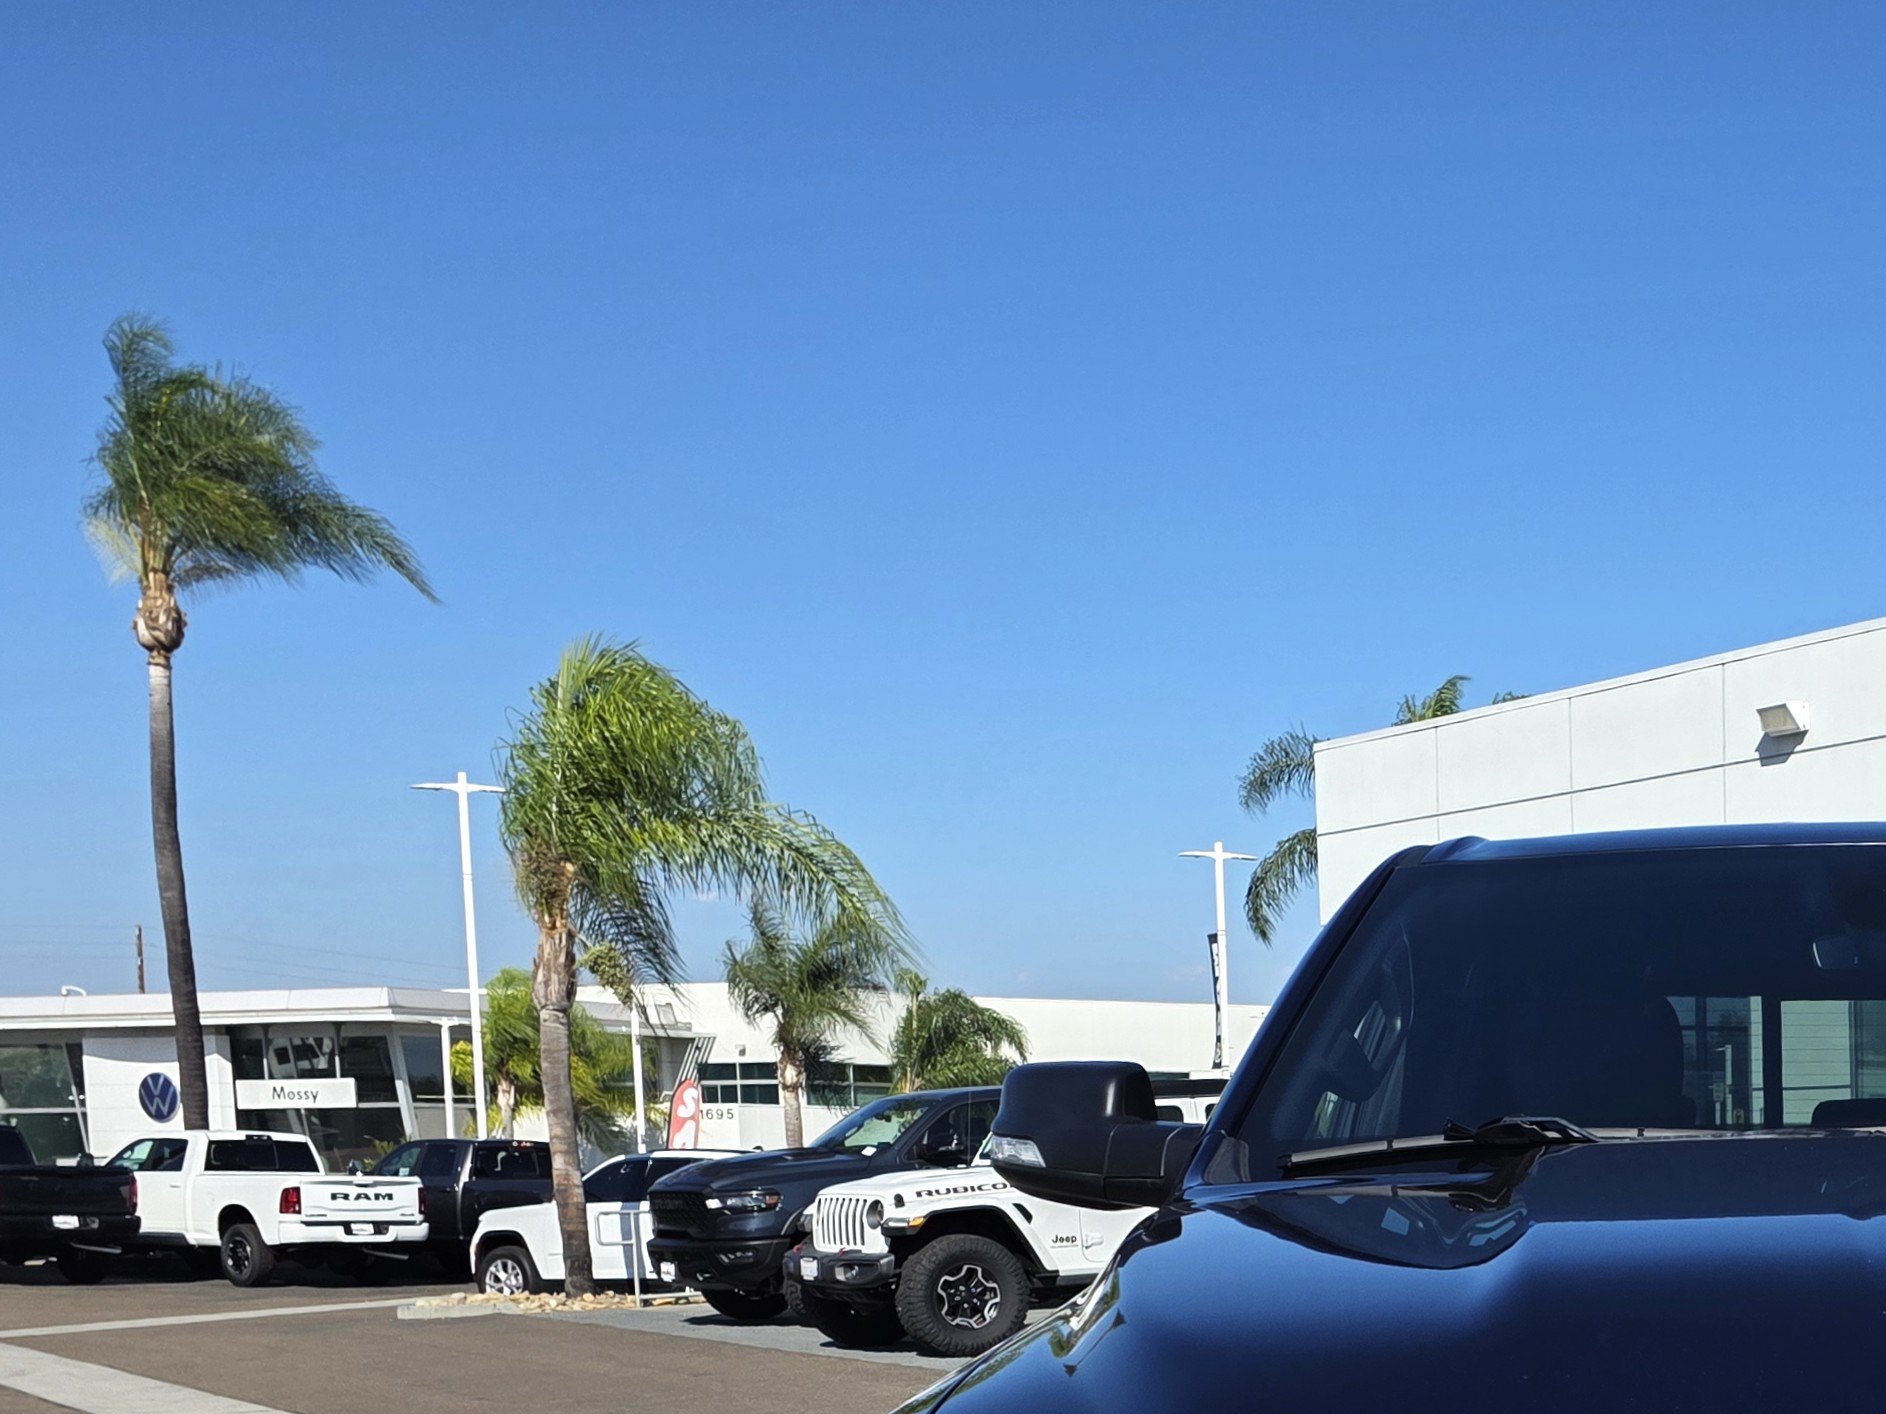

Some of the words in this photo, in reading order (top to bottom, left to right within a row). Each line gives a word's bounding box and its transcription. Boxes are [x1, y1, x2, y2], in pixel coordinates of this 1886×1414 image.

[272, 1086, 319, 1102] Mossy
[330, 1192, 394, 1201] RAM
[915, 1182, 1012, 1198] RUBICO
[1051, 1234, 1078, 1245] Jeep
